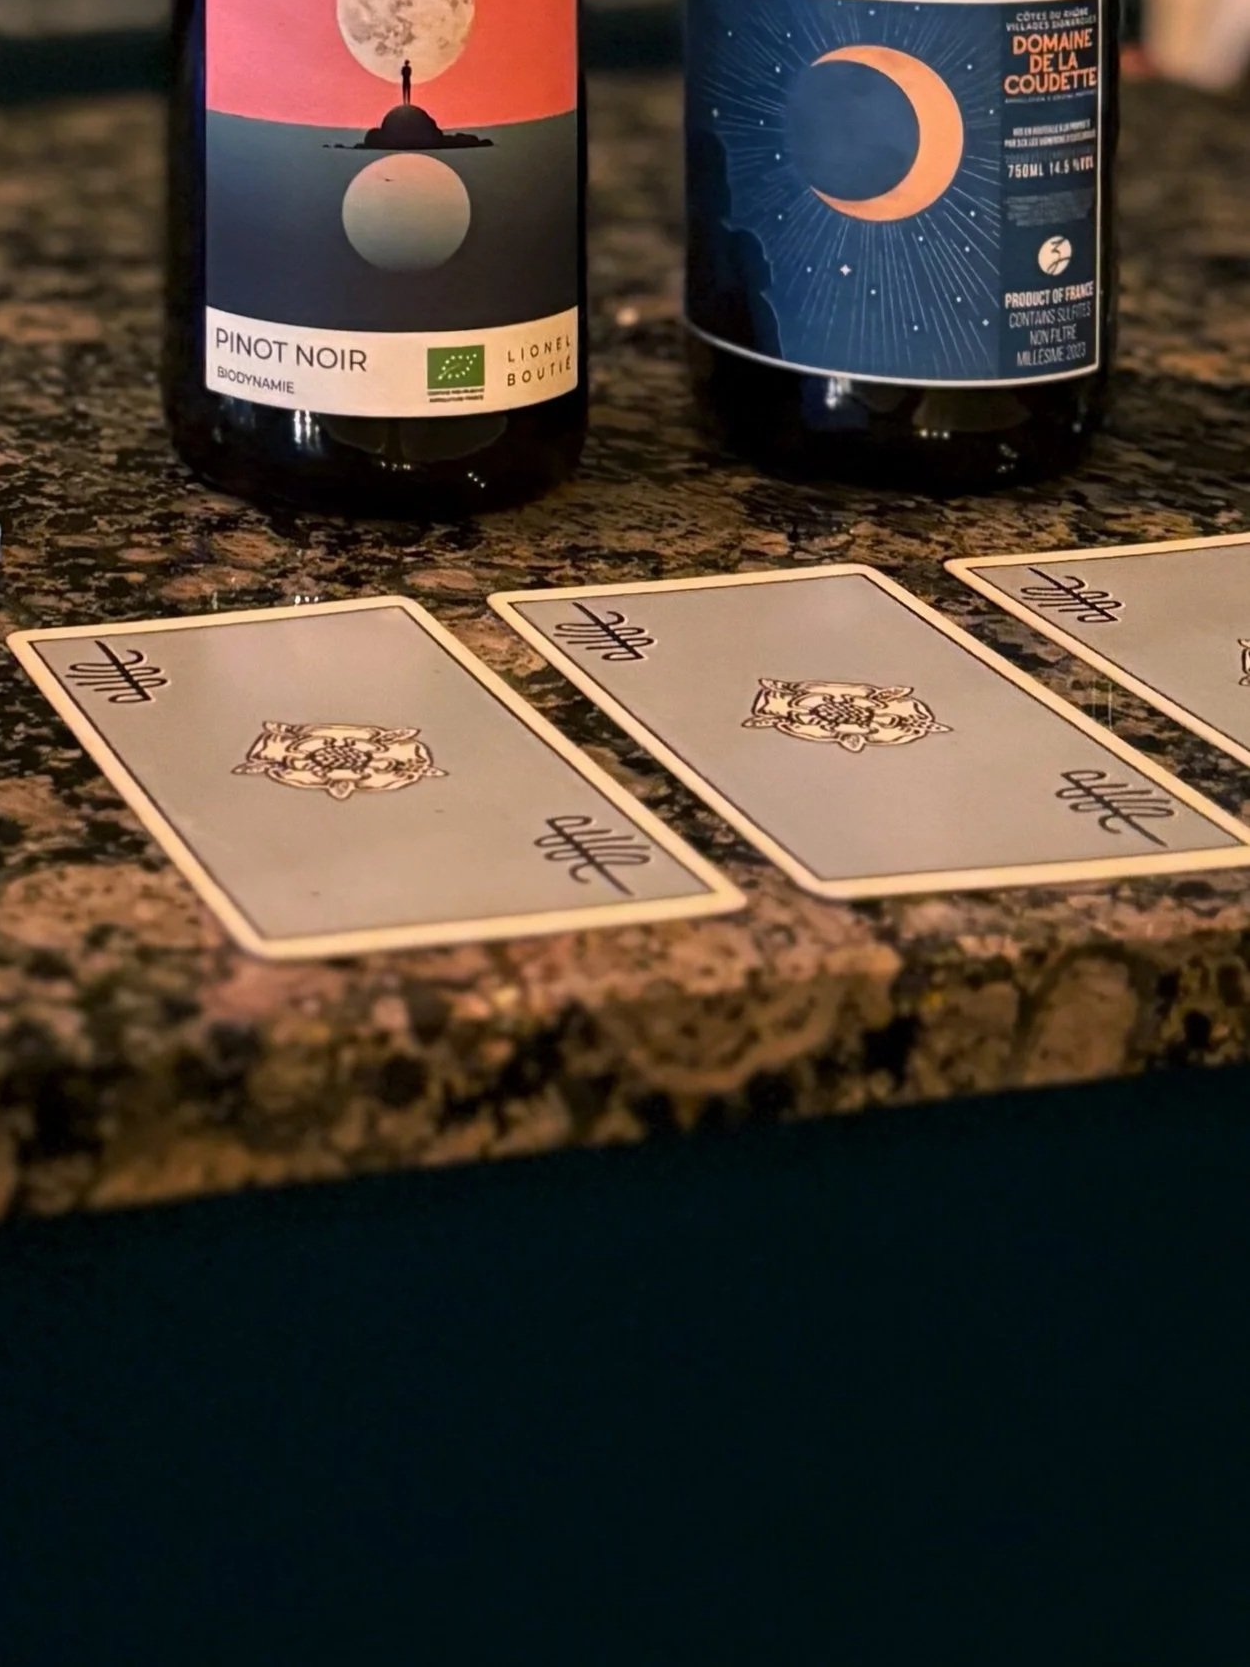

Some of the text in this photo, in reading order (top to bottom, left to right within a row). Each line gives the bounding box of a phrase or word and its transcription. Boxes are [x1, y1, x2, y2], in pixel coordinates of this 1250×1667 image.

[1012, 28, 1093, 55] DOMAINE
[1029, 51, 1078, 74] DE LA
[1004, 67, 1097, 95] COUDETTE
[1005, 280, 1094, 309] PRODUCT OF FRANCE
[1009, 308, 1056, 329] CONTAINS
[216, 327, 367, 372] PINOT NOIR
[507, 334, 570, 363] LIONEL
[1029, 328, 1049, 346] NON
[217, 366, 295, 394] BIODYNAMIE
